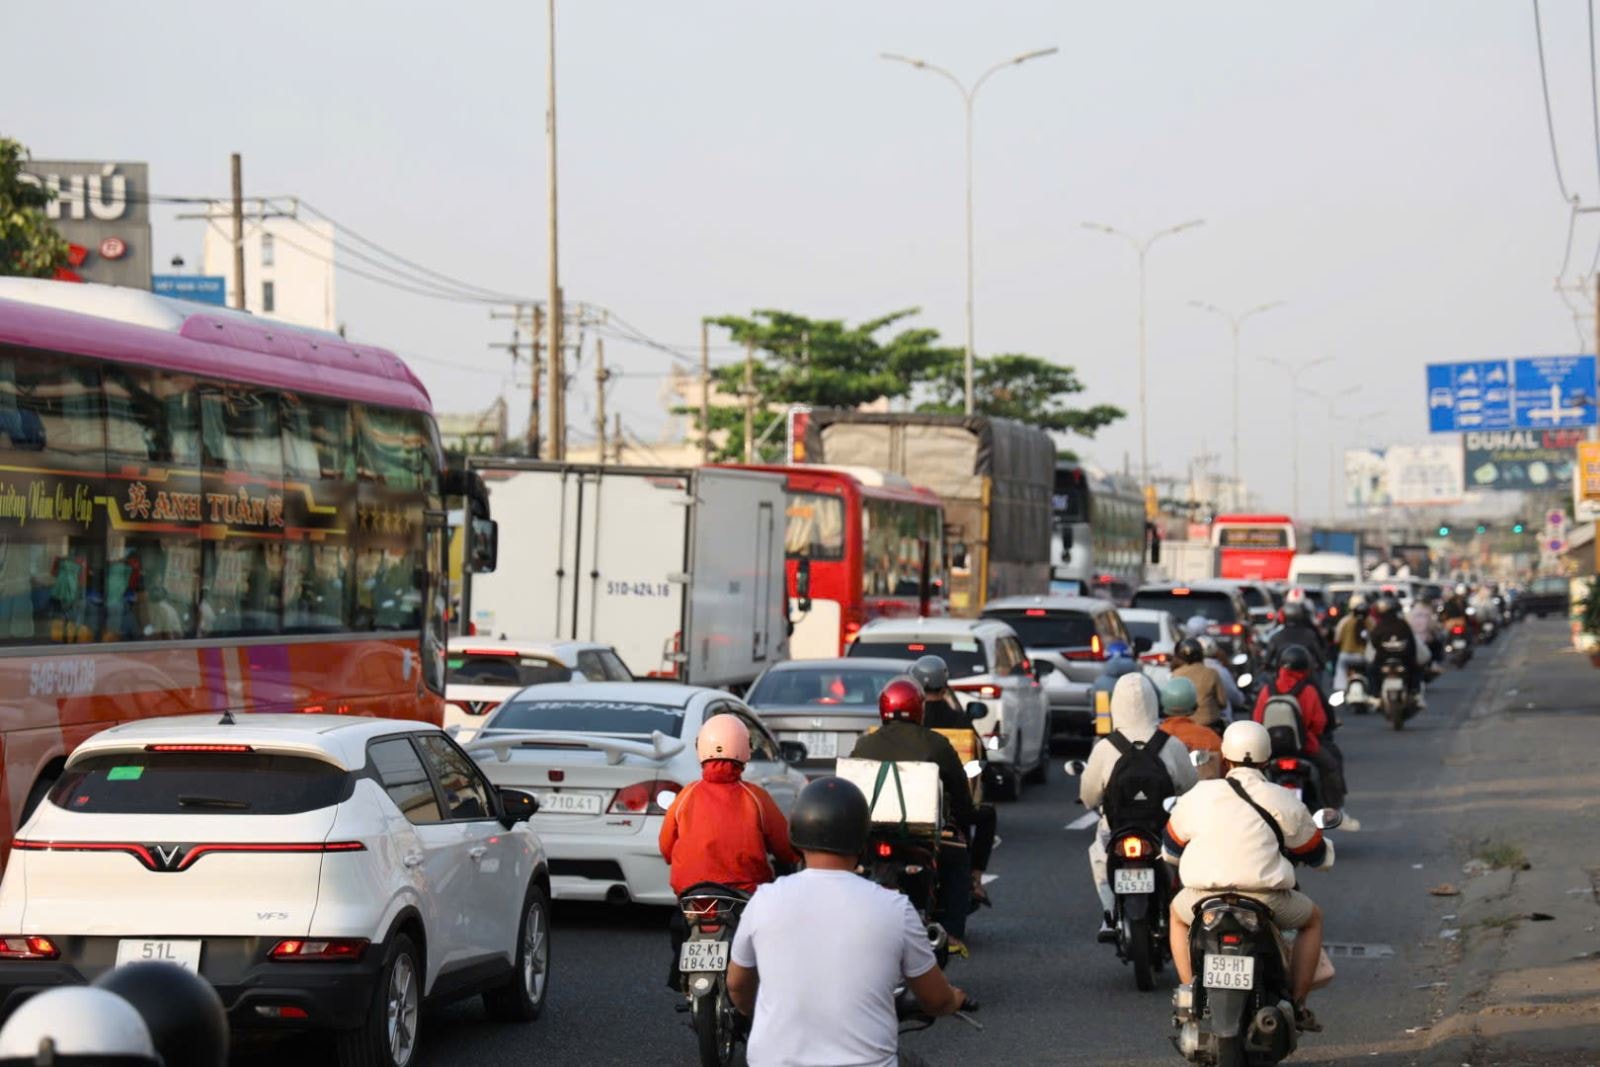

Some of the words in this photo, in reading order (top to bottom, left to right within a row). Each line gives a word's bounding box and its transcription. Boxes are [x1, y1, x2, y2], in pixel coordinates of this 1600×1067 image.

[152, 491, 202, 521] ANH
[142, 942, 177, 960] 51L
[688, 943, 720, 956] 62-K1
[684, 956, 724, 970] 184.49
[1212, 956, 1250, 972] 59-H1
[1207, 971, 1250, 988] 340.65
